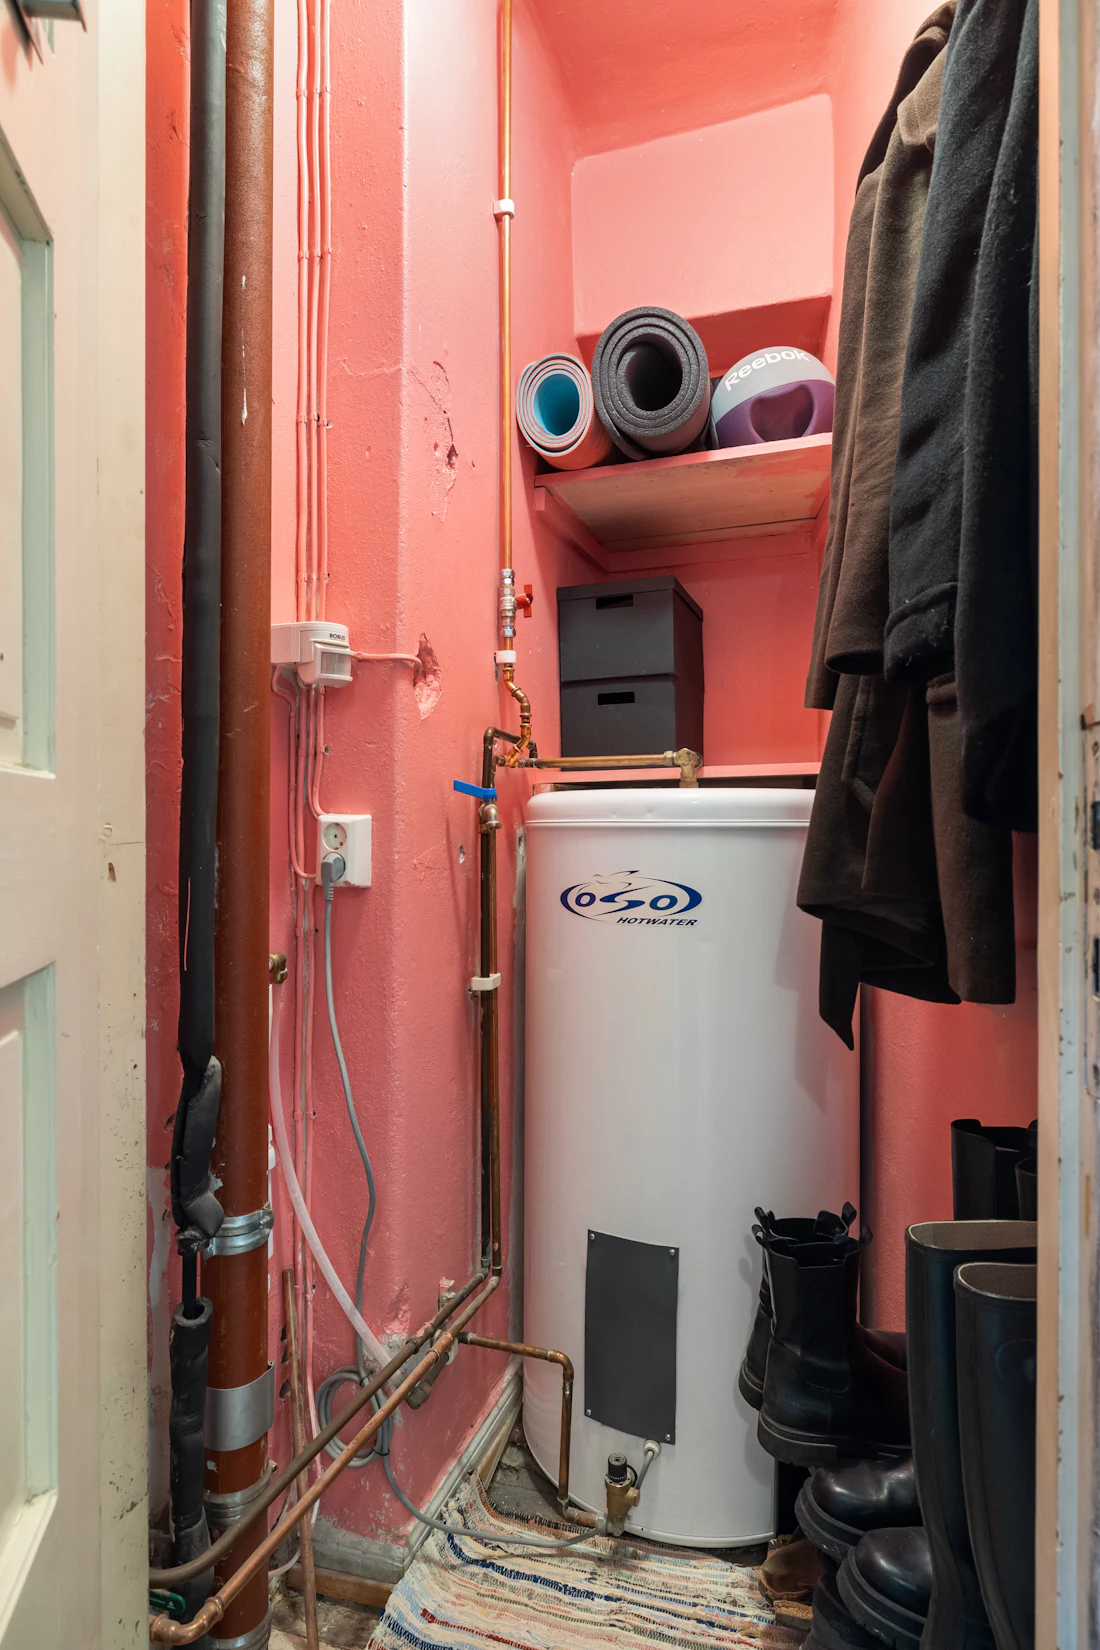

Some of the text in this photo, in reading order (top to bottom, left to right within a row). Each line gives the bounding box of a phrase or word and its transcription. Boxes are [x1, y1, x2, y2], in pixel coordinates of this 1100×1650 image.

[724, 350, 811, 391] Reebok
[329, 633, 346, 641] ROBUS
[616, 917, 698, 926] HOTWATER
